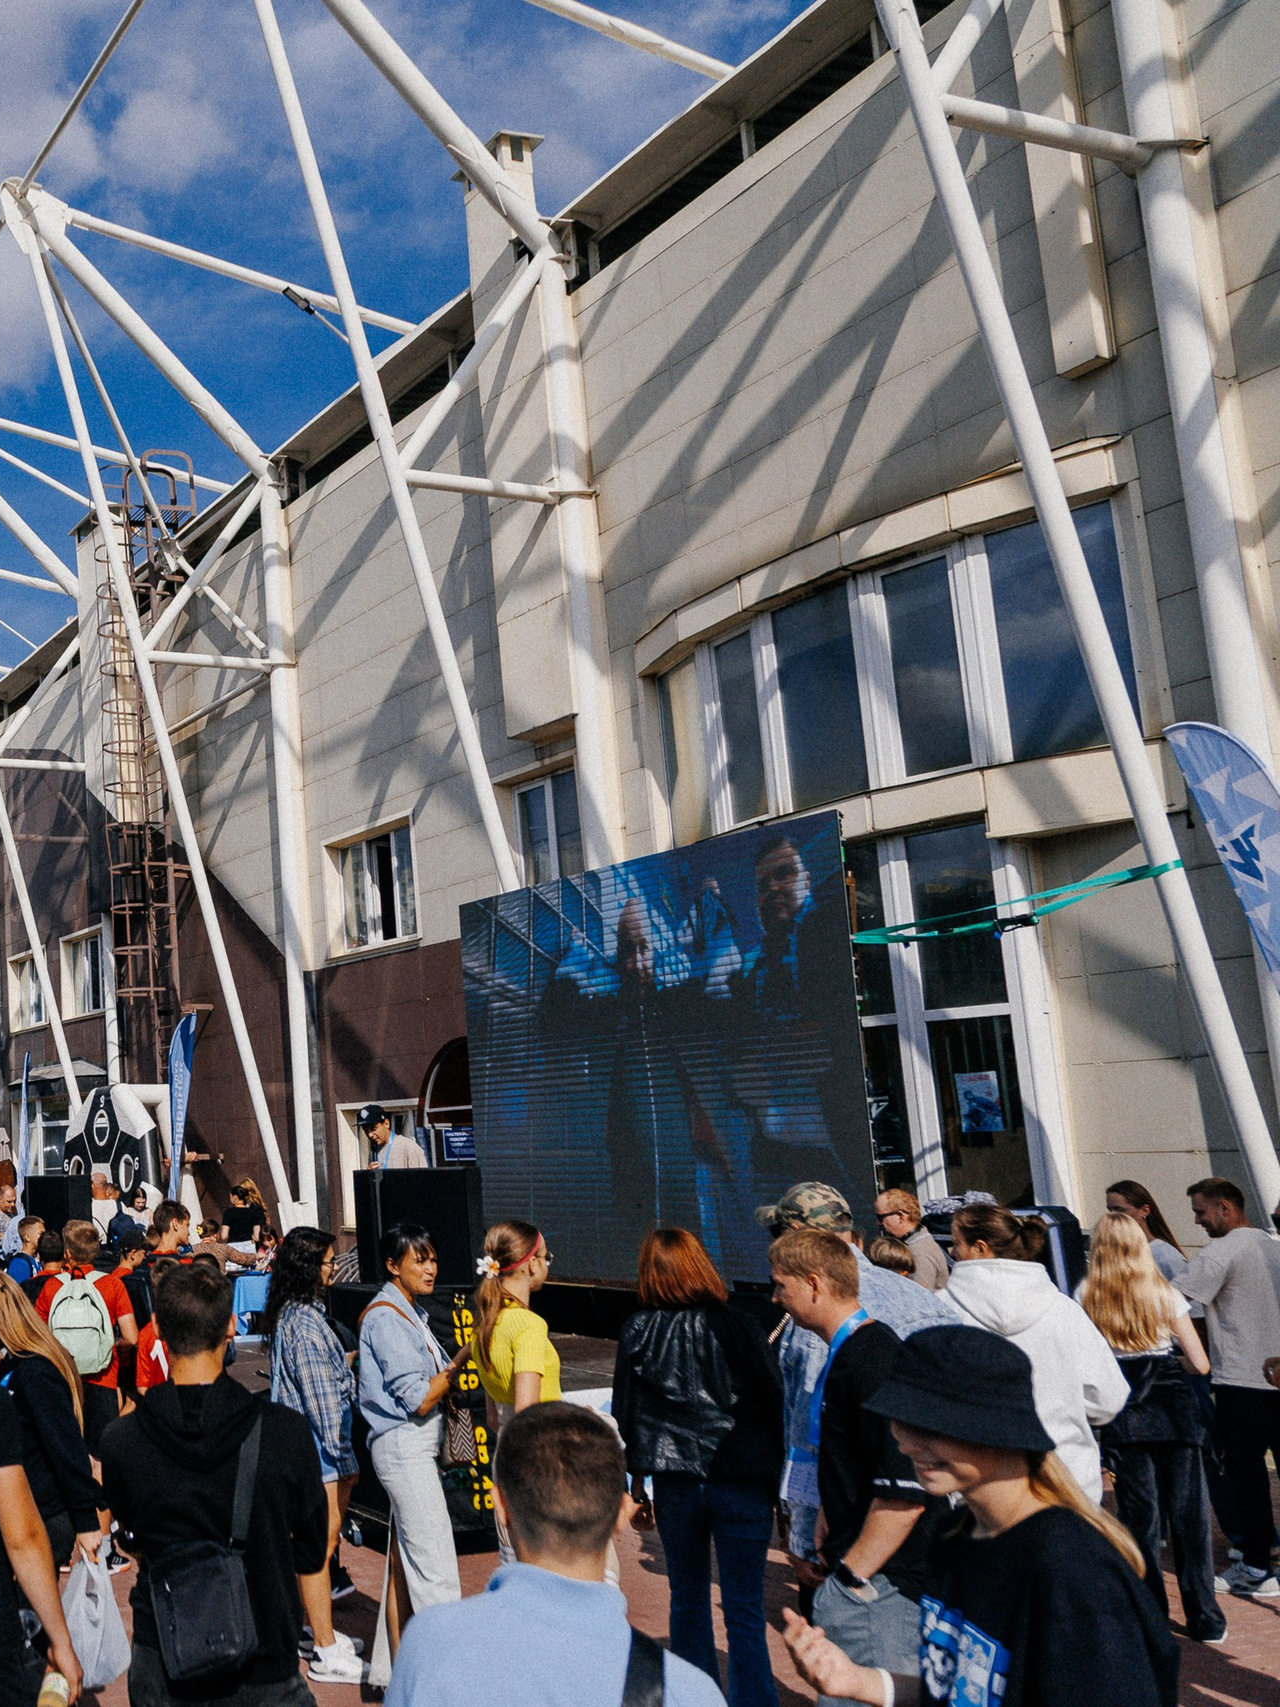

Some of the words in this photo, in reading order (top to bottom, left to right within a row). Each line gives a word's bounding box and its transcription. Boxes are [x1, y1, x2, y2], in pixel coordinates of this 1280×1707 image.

[99, 1095, 105, 1108] 9
[63, 1159, 69, 1172] 6
[134, 1156, 139, 1171] 6
